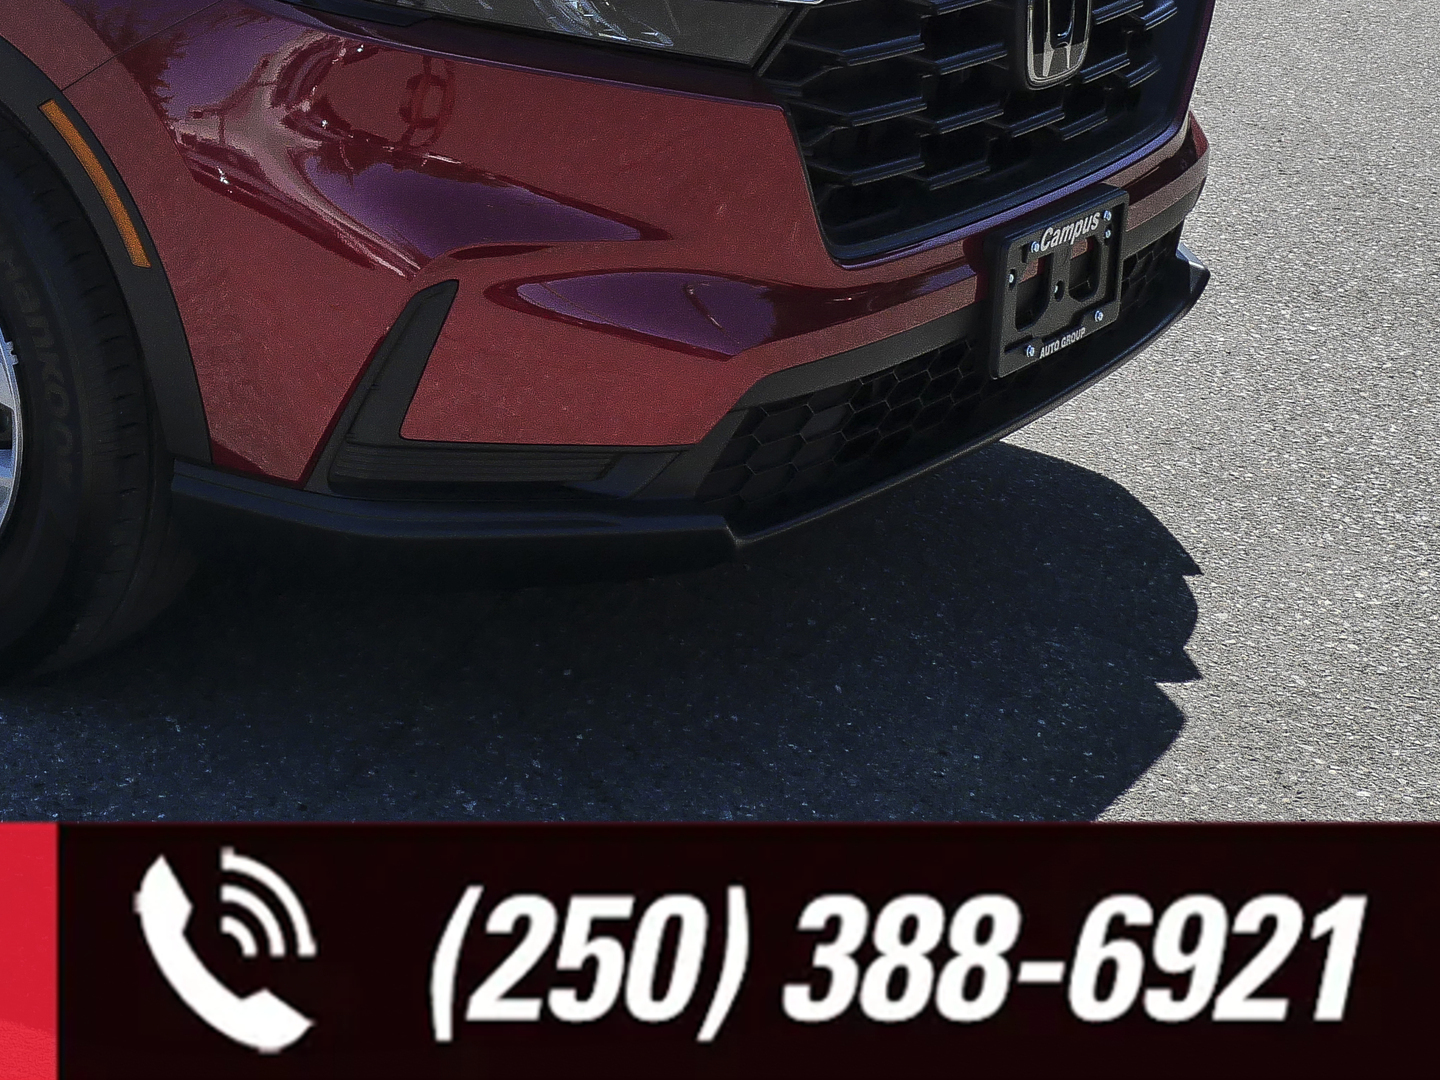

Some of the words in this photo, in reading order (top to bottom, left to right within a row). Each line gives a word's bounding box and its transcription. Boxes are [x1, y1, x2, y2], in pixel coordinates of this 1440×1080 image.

[1040, 211, 1101, 252] Campus
[1039, 340, 1060, 359] AUTO
[1060, 327, 1086, 350] GROUP
